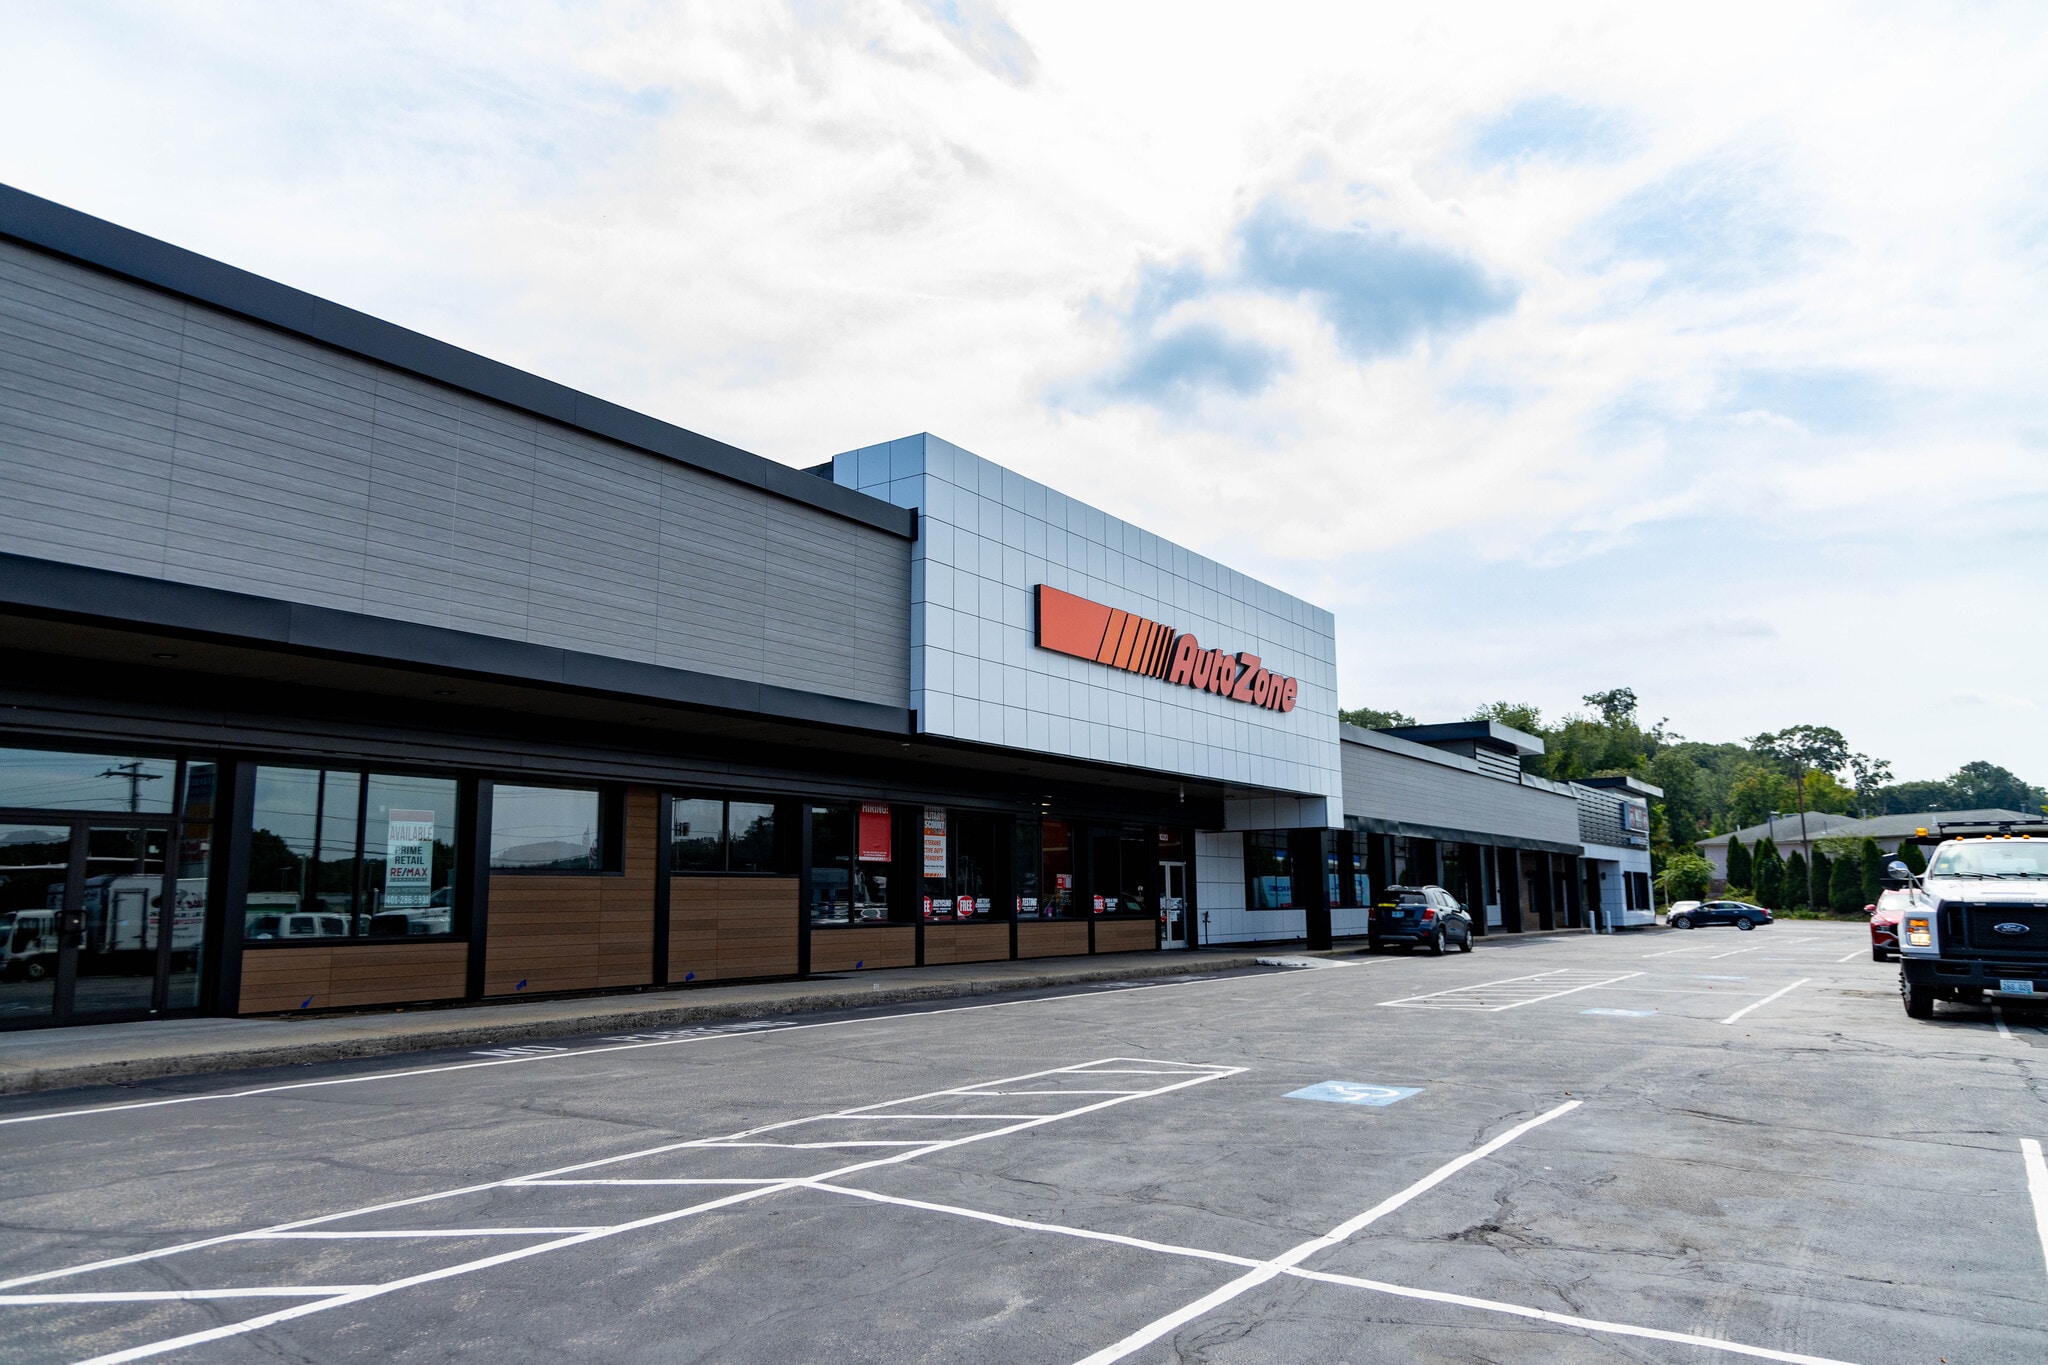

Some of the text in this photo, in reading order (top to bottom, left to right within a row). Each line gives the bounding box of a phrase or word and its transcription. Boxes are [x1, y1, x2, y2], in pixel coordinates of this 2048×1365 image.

[1166, 632, 1298, 713] AutoZone
[924, 821, 945, 829] SCOUNT
[389, 825, 433, 842] AVAILABLE
[395, 846, 423, 855] PRIME
[394, 856, 425, 865] RETAIL
[390, 868, 428, 877] RE/MAX
[960, 899, 973, 911] FREE
[469, 1021, 799, 1057] NO PARKING
